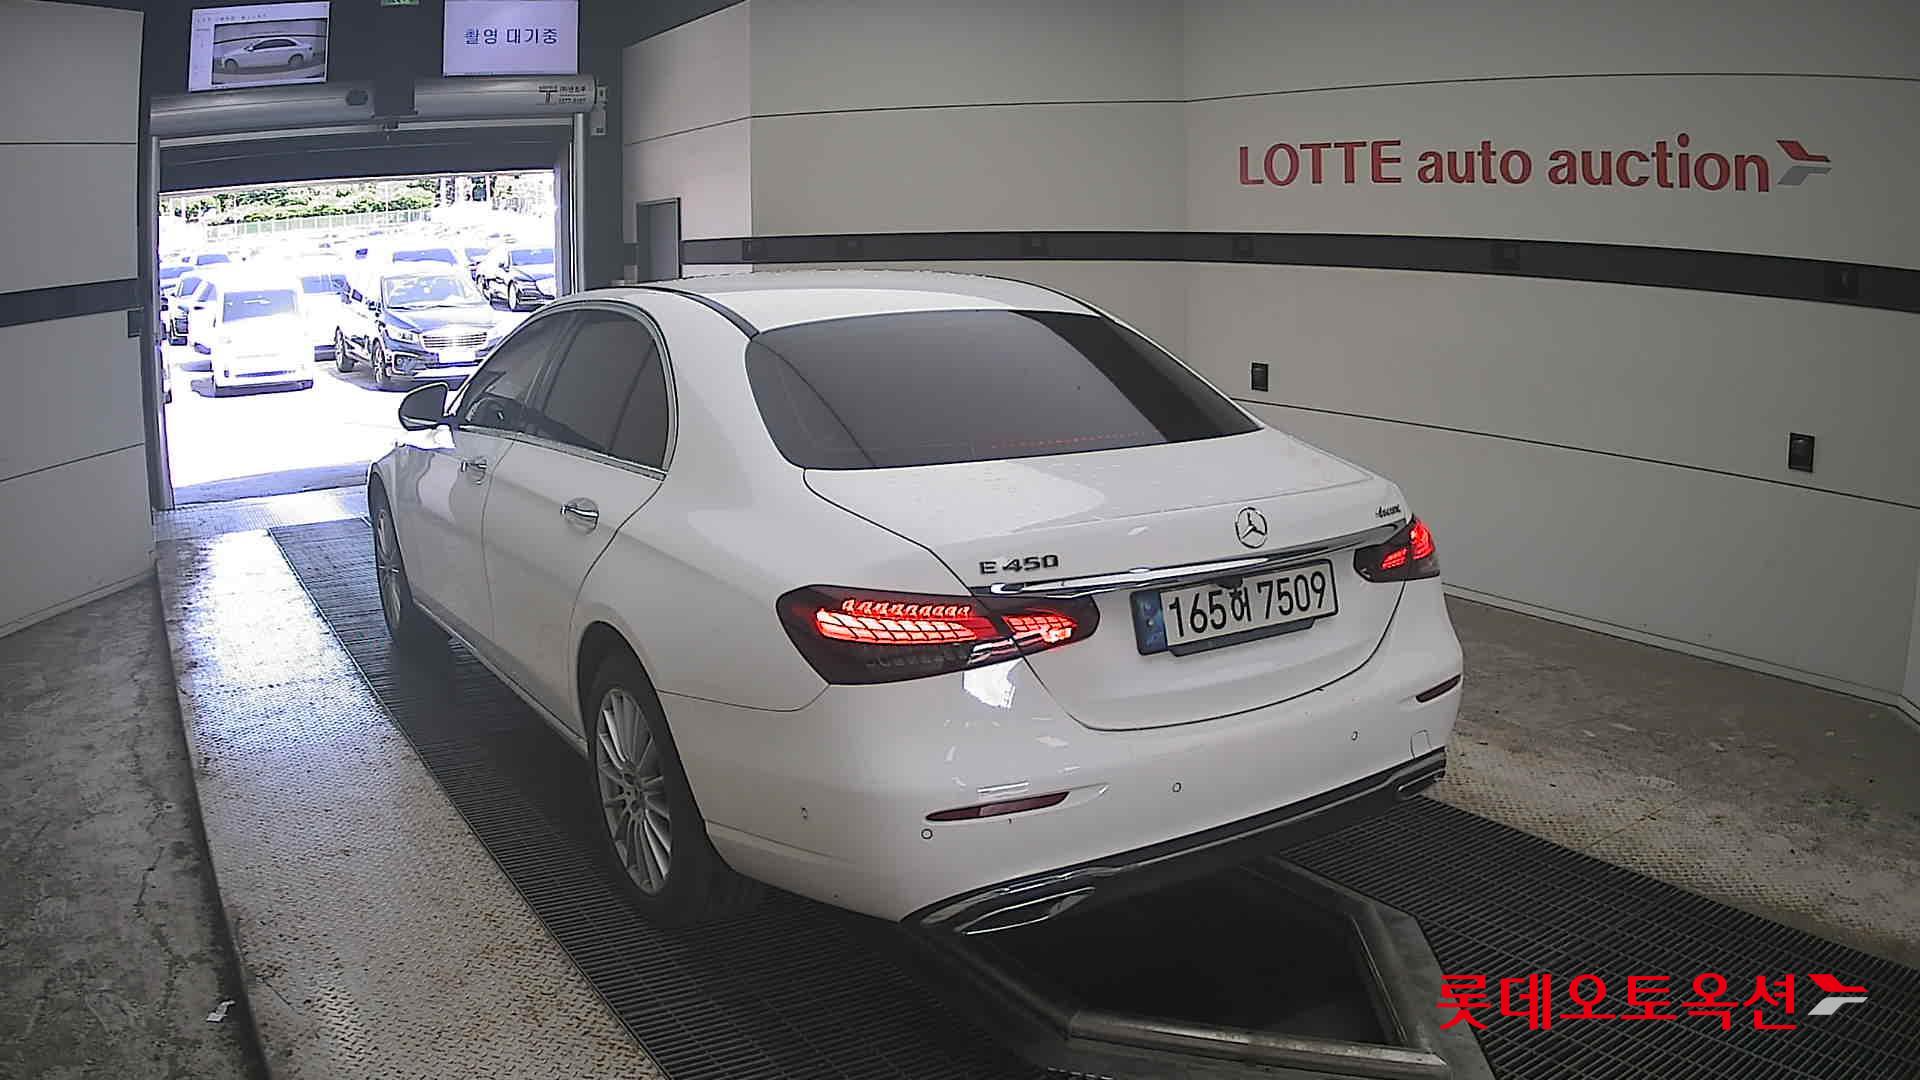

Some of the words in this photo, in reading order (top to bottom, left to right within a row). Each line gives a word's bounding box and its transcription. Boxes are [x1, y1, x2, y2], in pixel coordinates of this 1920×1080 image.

[506, 28, 558, 45] 대기중
[1239, 140, 1402, 186] LOTTE
[1416, 141, 1533, 185] auto
[1548, 132, 1770, 192] auction
[979, 560, 998, 575] E
[1002, 554, 1060, 573] 450
[1256, 571, 1327, 620] 7509
